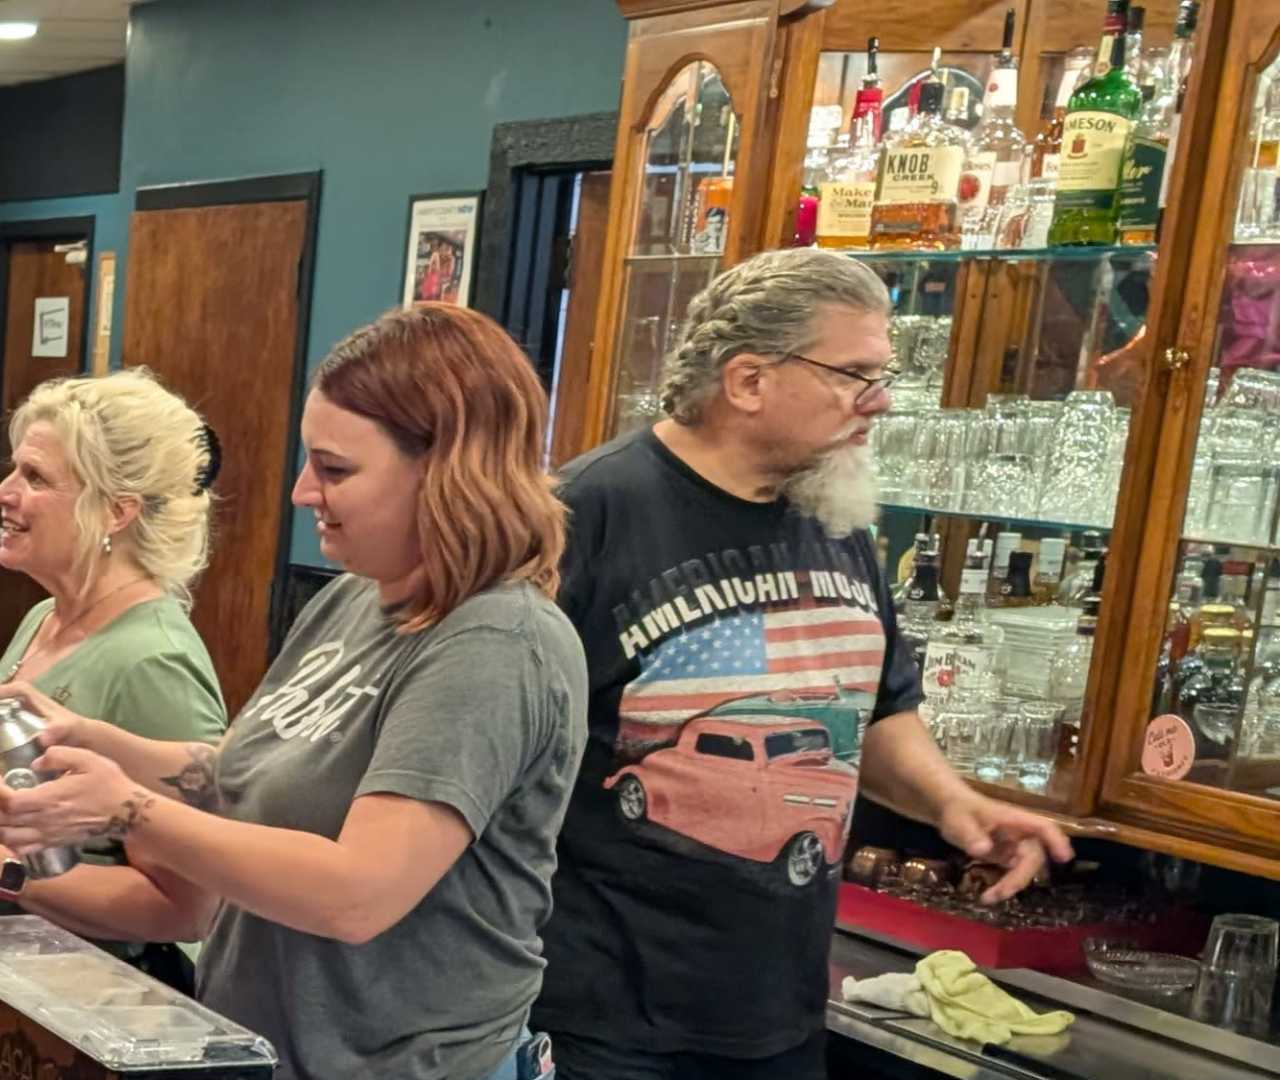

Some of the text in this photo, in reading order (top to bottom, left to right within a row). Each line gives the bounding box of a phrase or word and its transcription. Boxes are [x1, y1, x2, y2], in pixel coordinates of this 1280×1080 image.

[887, 152, 930, 175] KNOB
[892, 174, 936, 182] CREEK
[831, 186, 873, 198] Make
[844, 198, 873, 208] Mar
[614, 550, 799, 659] AMERICAN
